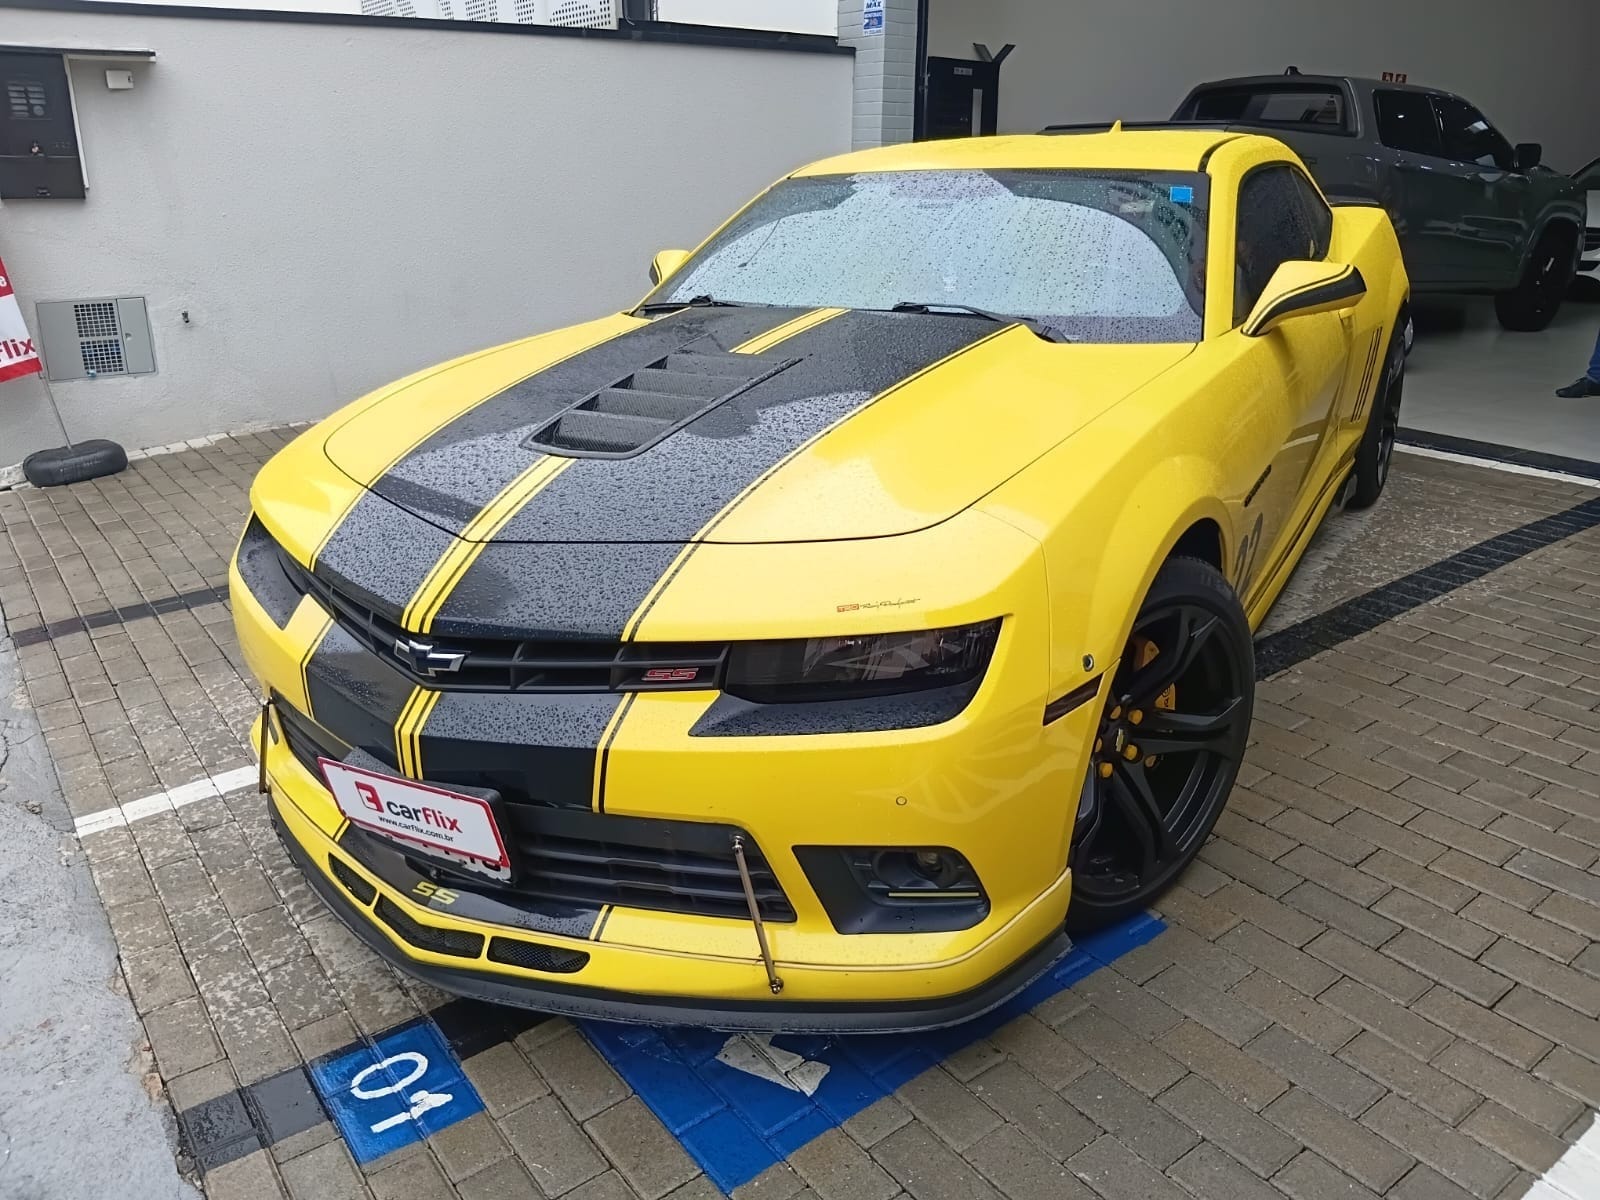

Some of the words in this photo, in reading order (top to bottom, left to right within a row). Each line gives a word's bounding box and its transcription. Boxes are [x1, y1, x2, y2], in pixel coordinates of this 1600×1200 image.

[0, 338, 36, 362] lix
[641, 667, 699, 681] SS
[411, 881, 460, 905] SS
[350, 1051, 453, 1134] 01
